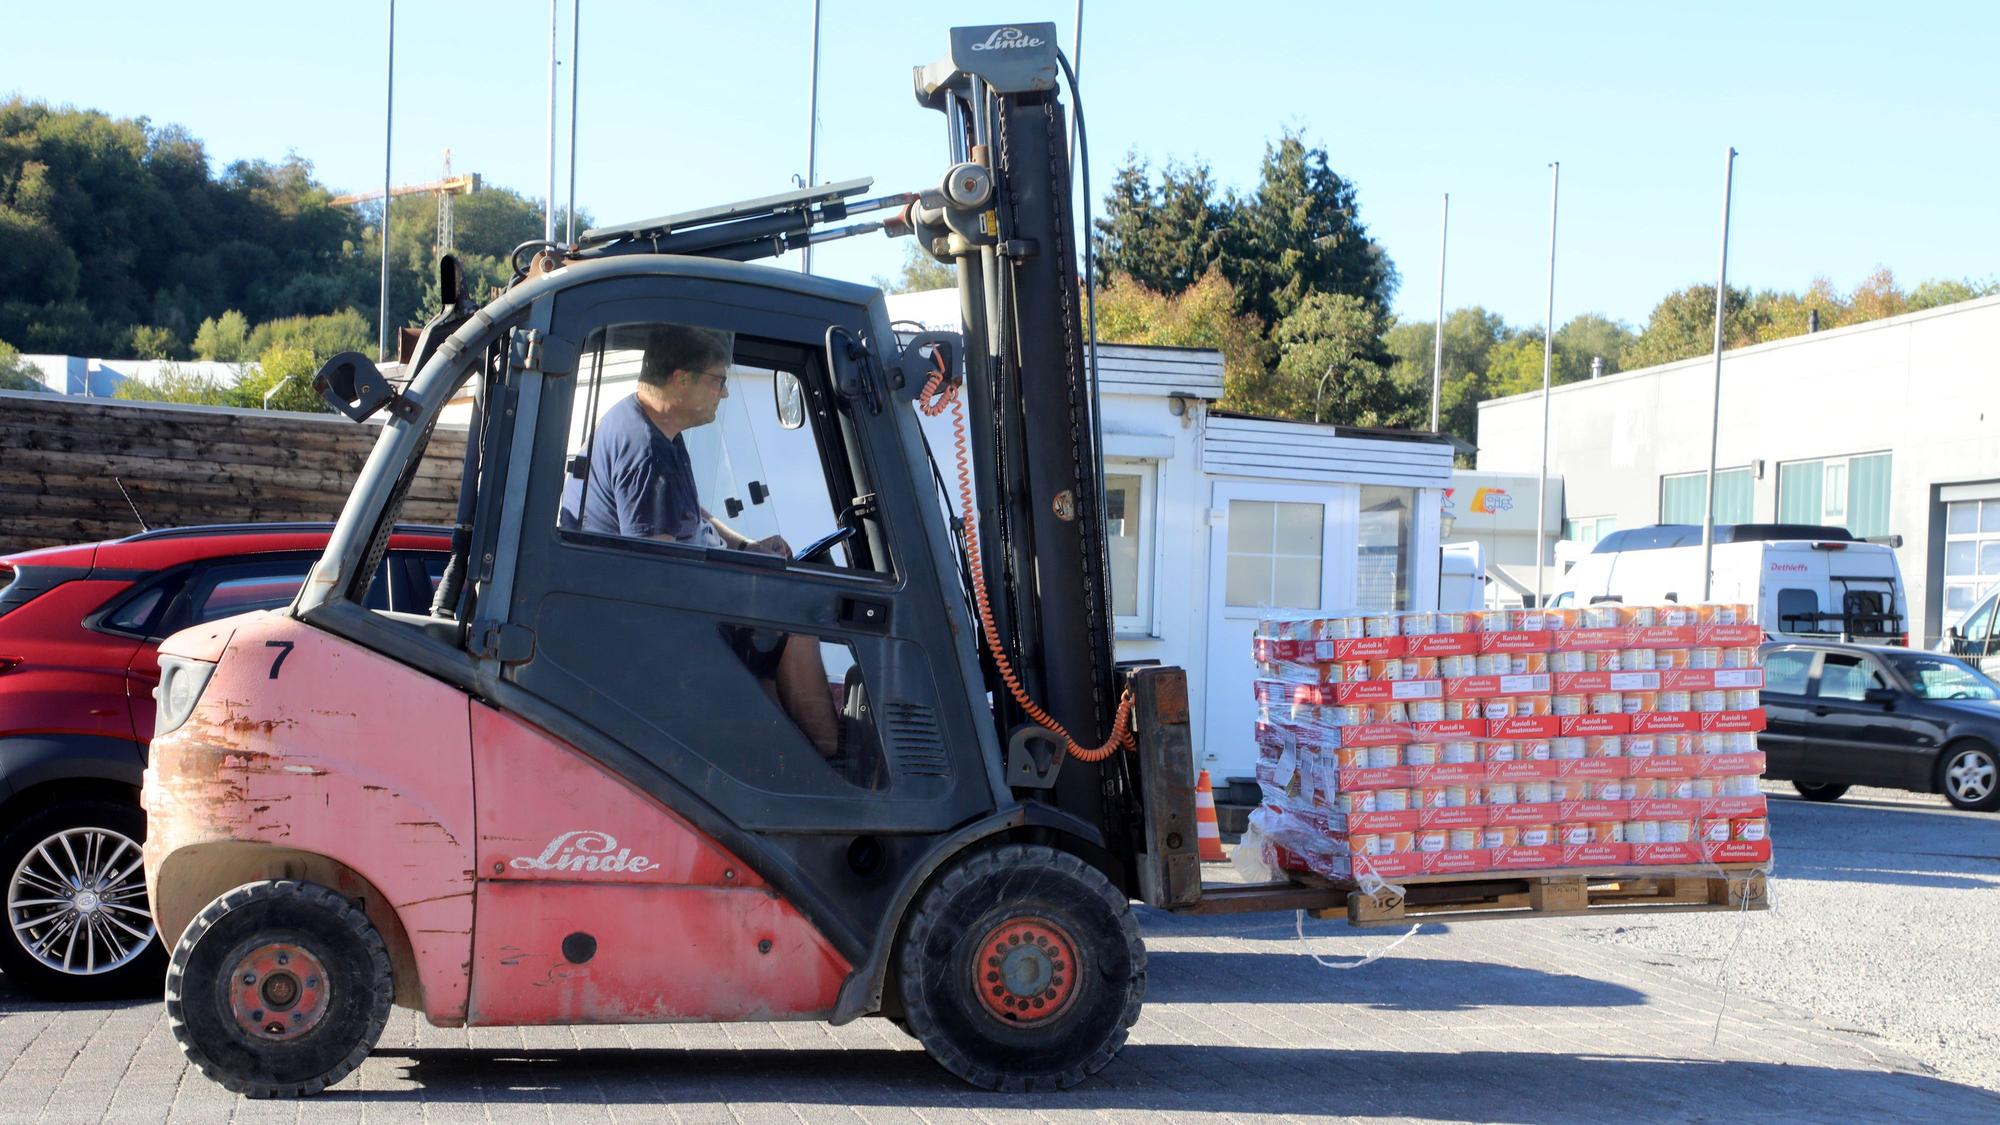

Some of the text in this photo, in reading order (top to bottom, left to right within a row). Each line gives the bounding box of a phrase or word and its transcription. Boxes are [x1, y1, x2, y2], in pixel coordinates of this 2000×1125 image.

[972, 28, 1045, 50] Linde
[1770, 562, 1808, 572] Dethleffs
[265, 640, 294, 679] 7
[510, 830, 660, 872] Linde
